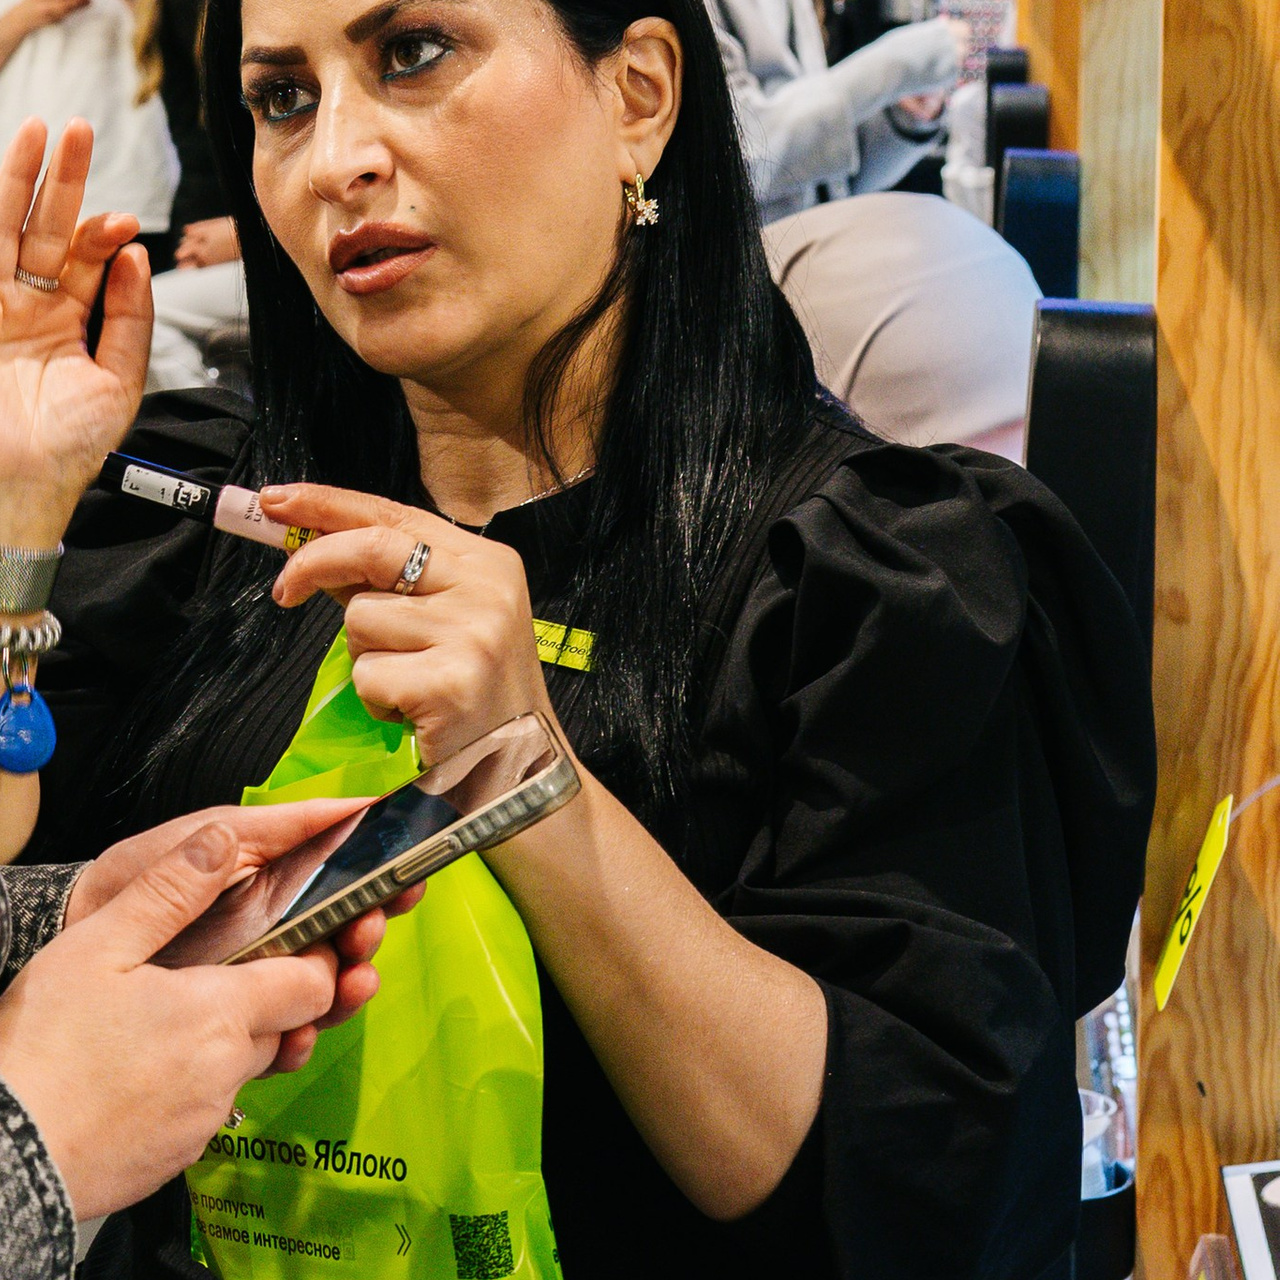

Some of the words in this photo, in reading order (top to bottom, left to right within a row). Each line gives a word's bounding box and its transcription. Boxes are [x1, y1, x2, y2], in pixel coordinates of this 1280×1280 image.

[314, 1138, 408, 1183] Яблоко
[201, 1193, 265, 1219] пропусти
[208, 1222, 250, 1245] самое
[253, 1230, 340, 1261] интересное
